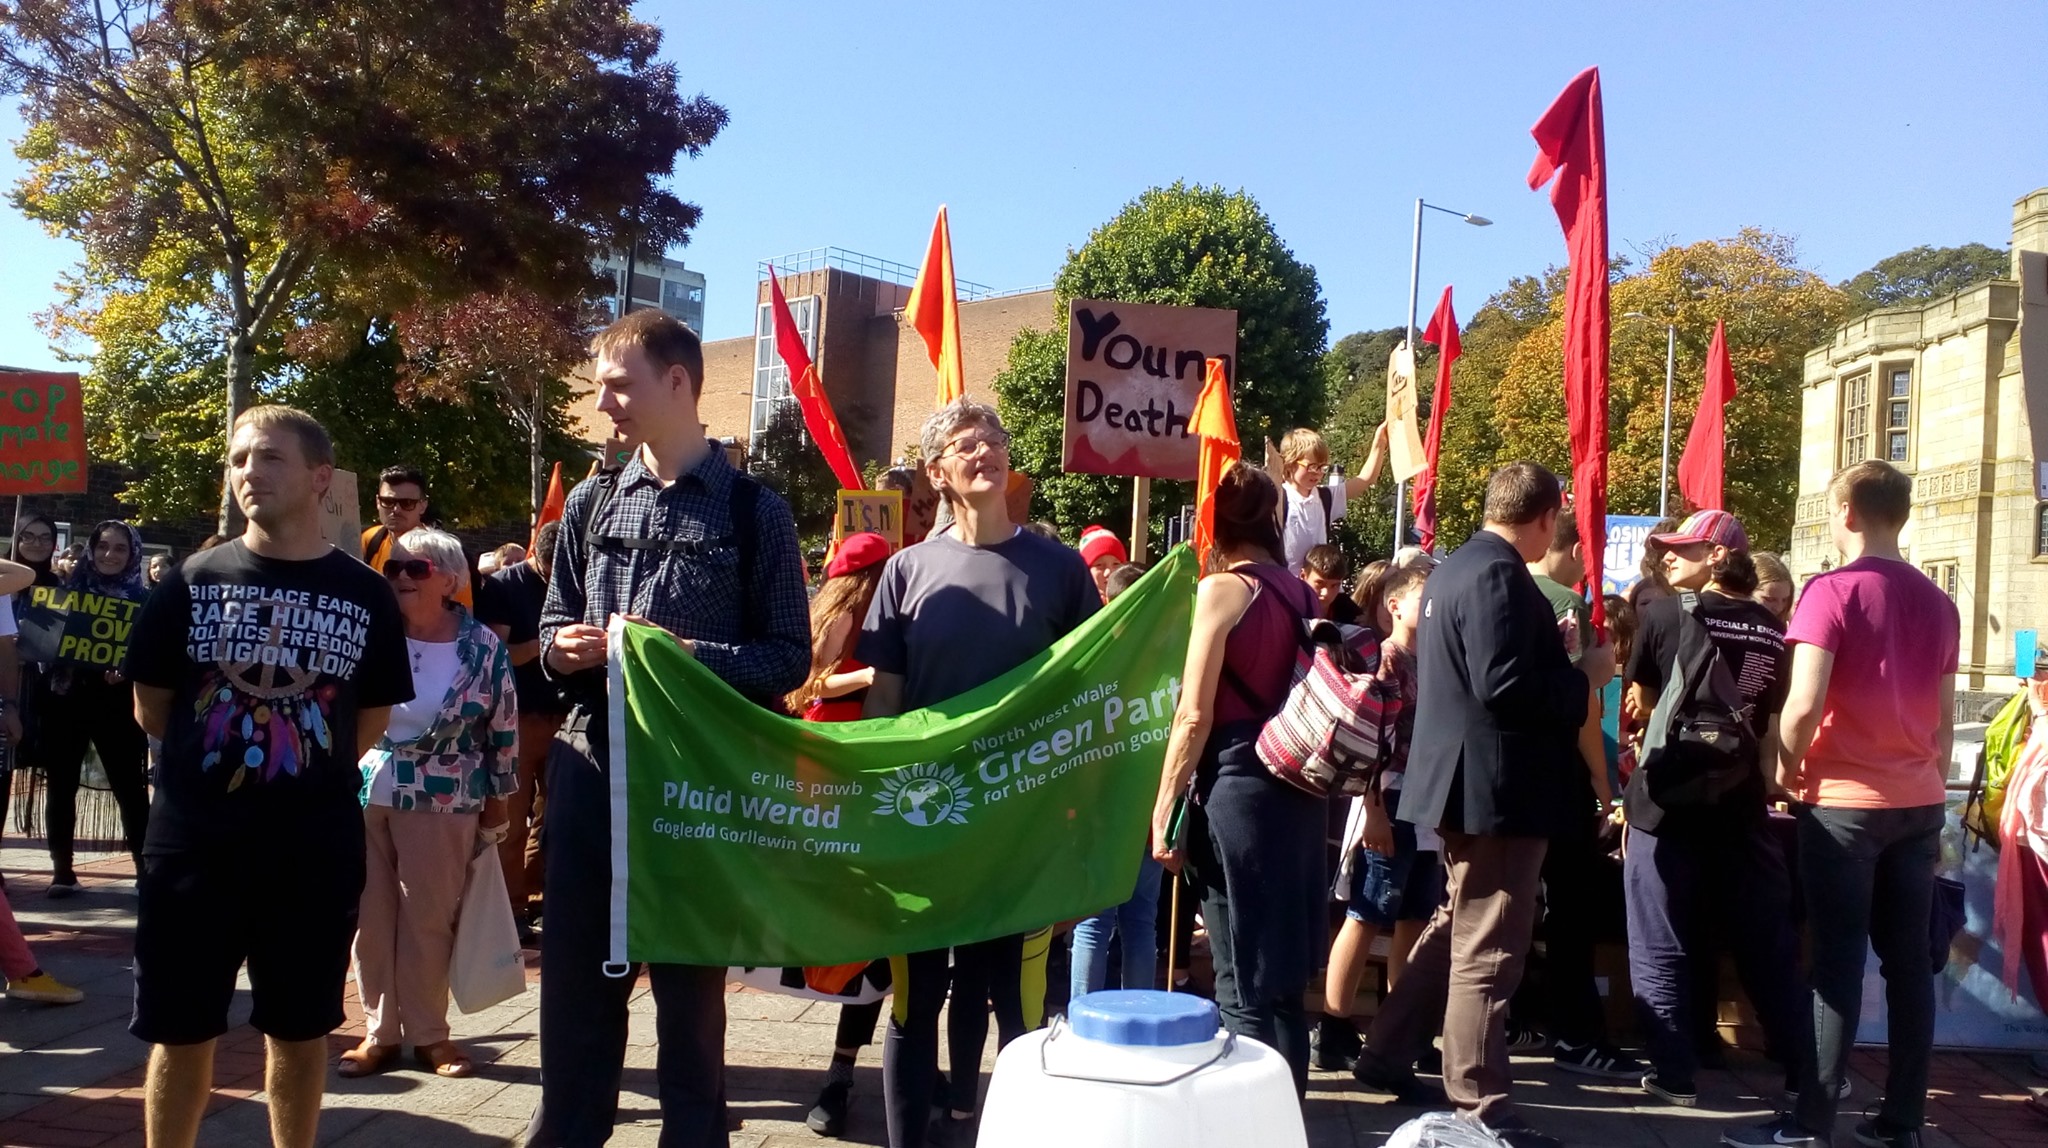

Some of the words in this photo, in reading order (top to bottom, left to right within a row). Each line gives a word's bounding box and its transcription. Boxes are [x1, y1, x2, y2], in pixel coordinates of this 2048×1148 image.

[1076, 379, 1189, 439] Death
[1606, 526, 1651, 545] OSIN
[31, 587, 141, 621] PLANET
[189, 585, 310, 606] BIRTHPLACE
[317, 594, 371, 625] EARTH
[192, 601, 260, 624] RACE
[271, 605, 367, 647] HUMAN
[1704, 617, 1750, 631] SPECIALS
[187, 639, 298, 668] RELIGION
[308, 651, 356, 681] LOVE
[188, 624, 271, 642] POLITICS
[279, 629, 363, 661] FREEDOM
[972, 726, 1025, 754] North
[1029, 703, 1070, 732] West
[1072, 680, 1119, 708] Wales
[978, 719, 1093, 785] Green
[983, 784, 1010, 805] for
[1016, 773, 1046, 794] the
[1050, 740, 1126, 780] common
[1130, 722, 1172, 752] good
[663, 781, 732, 814] Plaid
[741, 795, 840, 829] Werdd
[751, 771, 770, 786] er
[775, 774, 804, 793] lles
[810, 781, 863, 798] pawb
[652, 817, 716, 839] Gogledd
[719, 826, 797, 850] Gorllewin
[803, 838, 861, 856] Cymru
